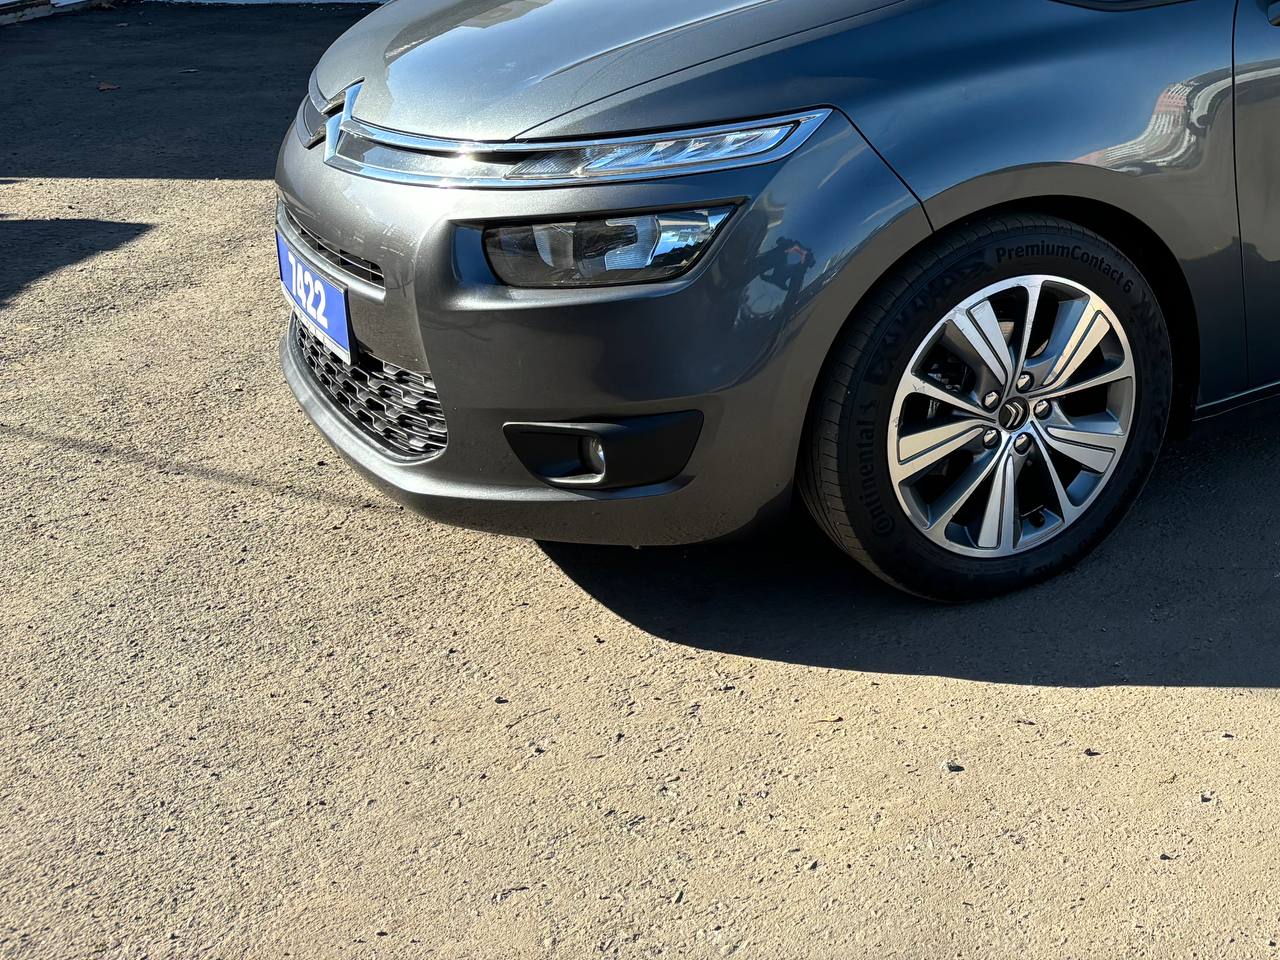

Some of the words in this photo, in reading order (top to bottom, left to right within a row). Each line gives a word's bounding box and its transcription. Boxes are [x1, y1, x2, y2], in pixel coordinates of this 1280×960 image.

[288, 253, 328, 329] 7422
[995, 240, 1125, 286] PremiumContact
[856, 420, 895, 536] Continental
